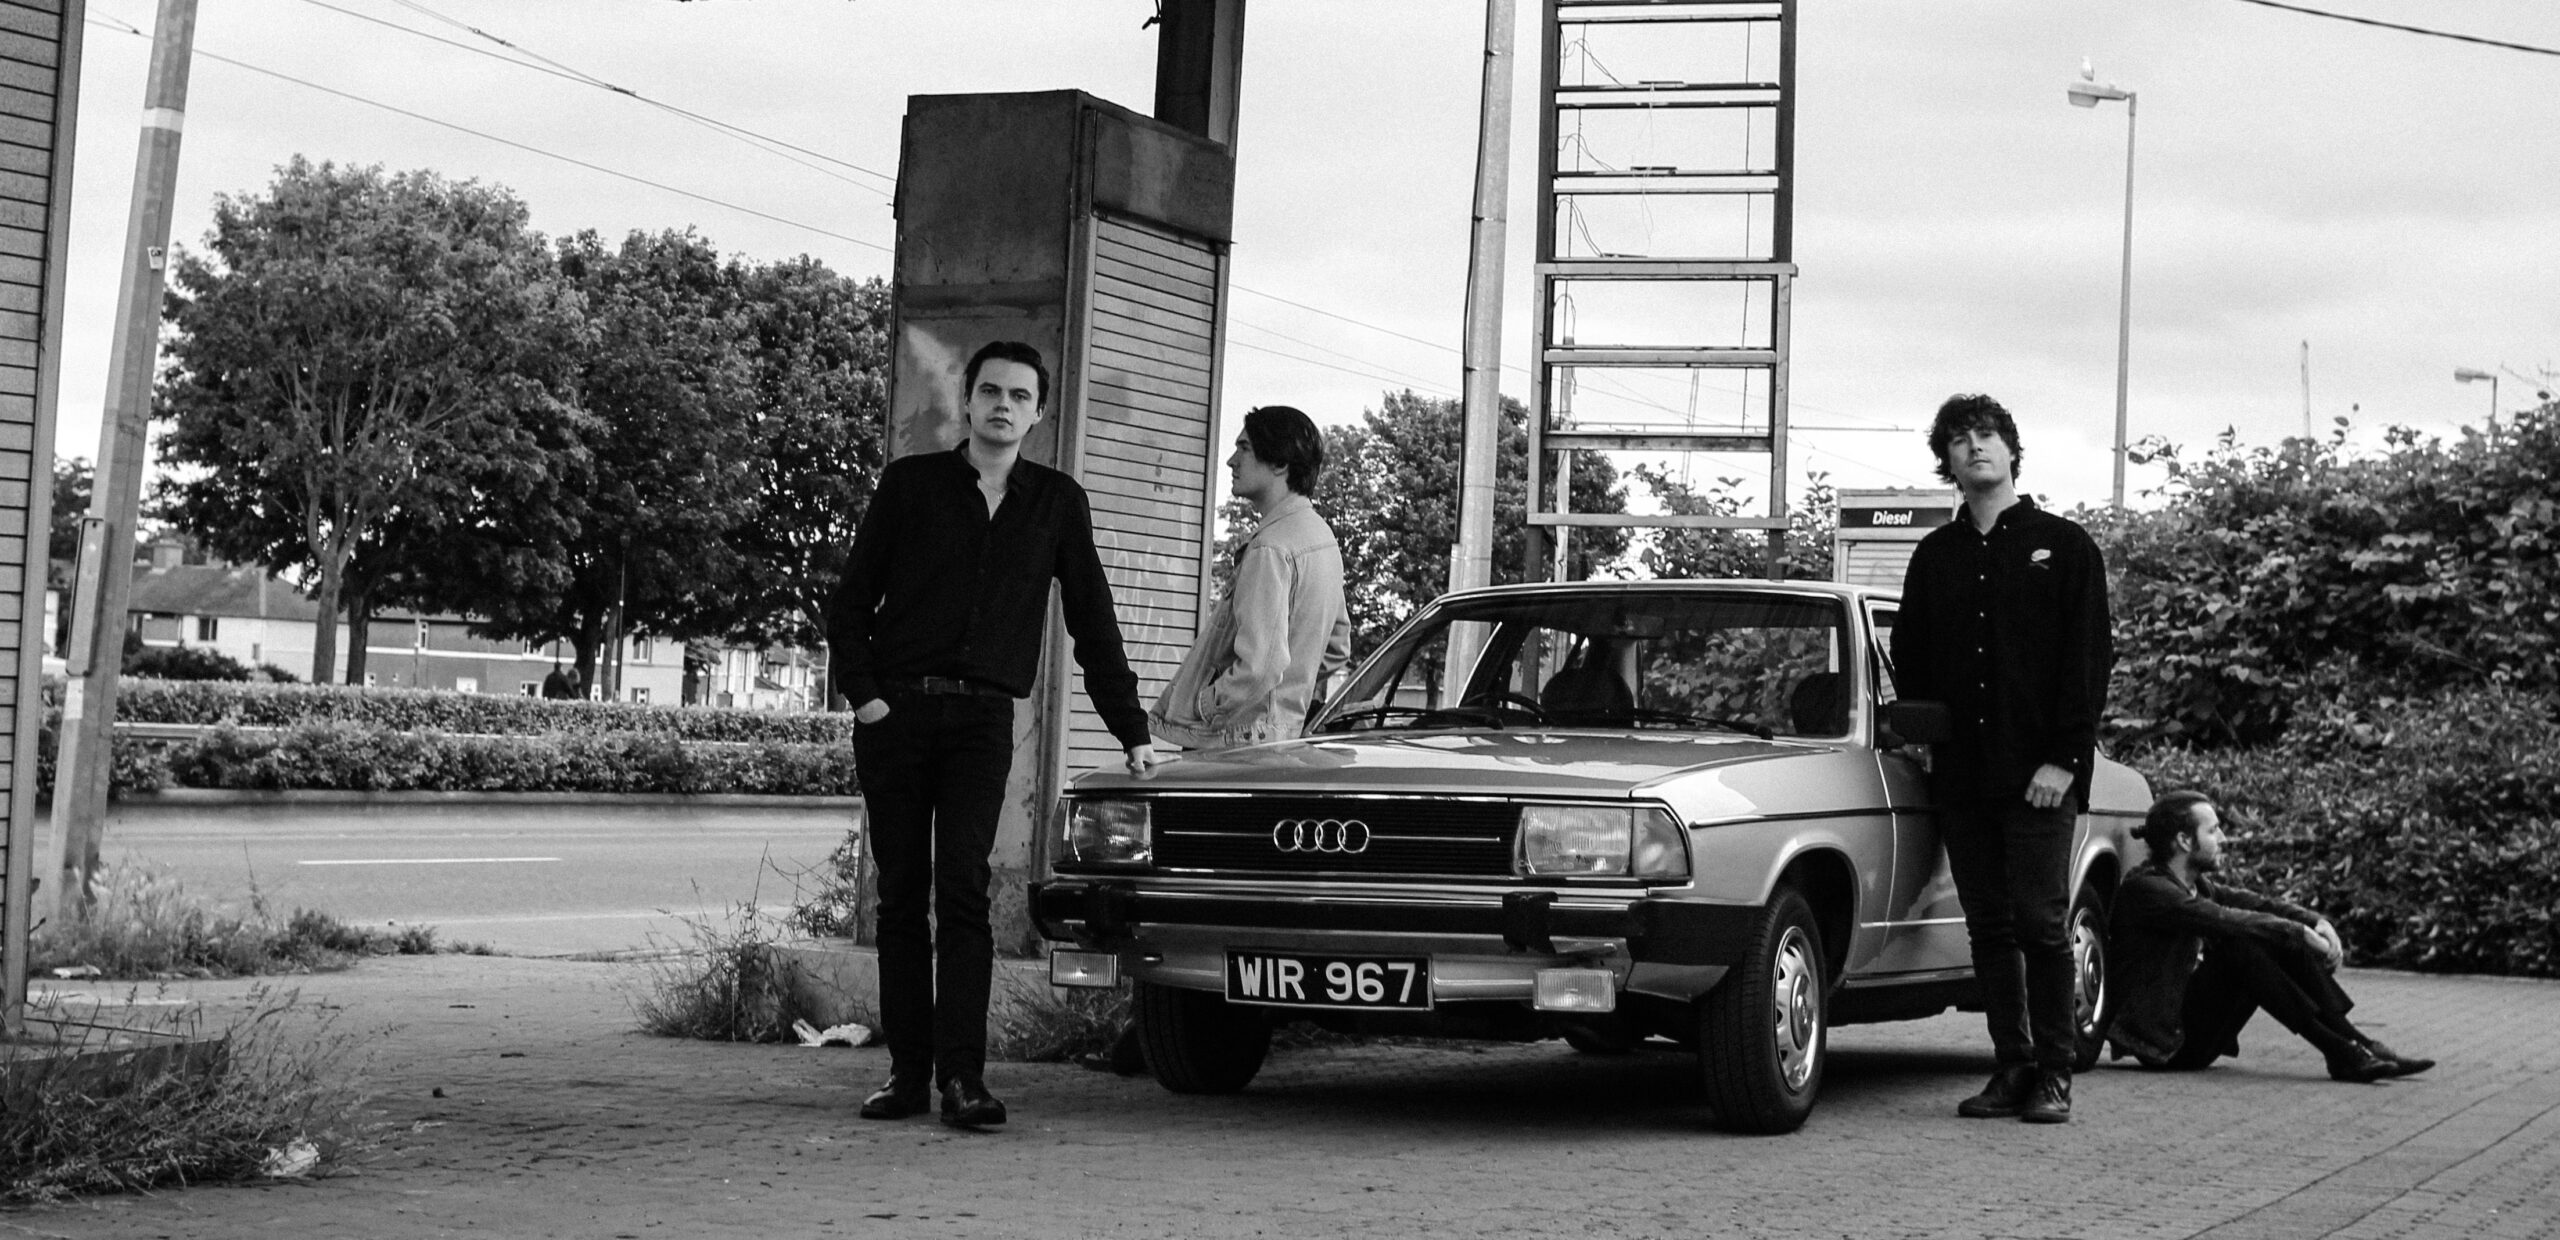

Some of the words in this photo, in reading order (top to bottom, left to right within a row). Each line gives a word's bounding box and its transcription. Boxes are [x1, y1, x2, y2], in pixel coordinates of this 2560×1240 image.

[1872, 510, 1913, 525] Diesel
[1237, 955, 1306, 1000] WIR
[1325, 961, 1416, 1004] 967
